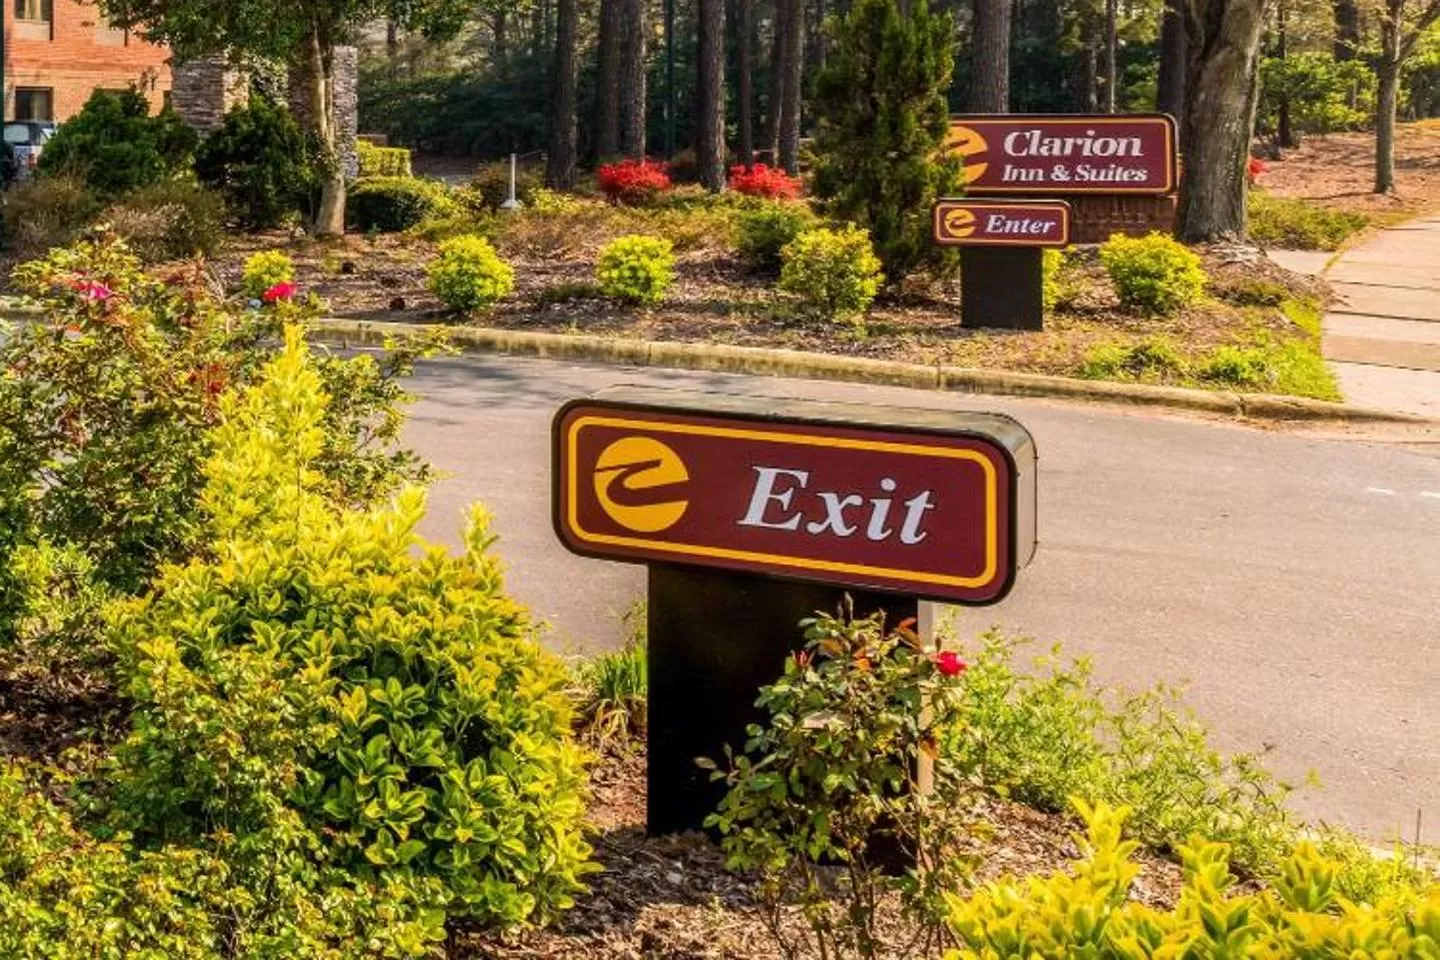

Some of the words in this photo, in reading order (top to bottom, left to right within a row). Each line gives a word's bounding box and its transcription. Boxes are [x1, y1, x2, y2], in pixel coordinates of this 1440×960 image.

[1003, 130, 1144, 157] Clarion
[1002, 164, 1044, 182] Inn
[1050, 164, 1071, 182] &
[1074, 164, 1148, 182] Suites
[985, 214, 1056, 234] Enter
[736, 465, 936, 545] Exit
